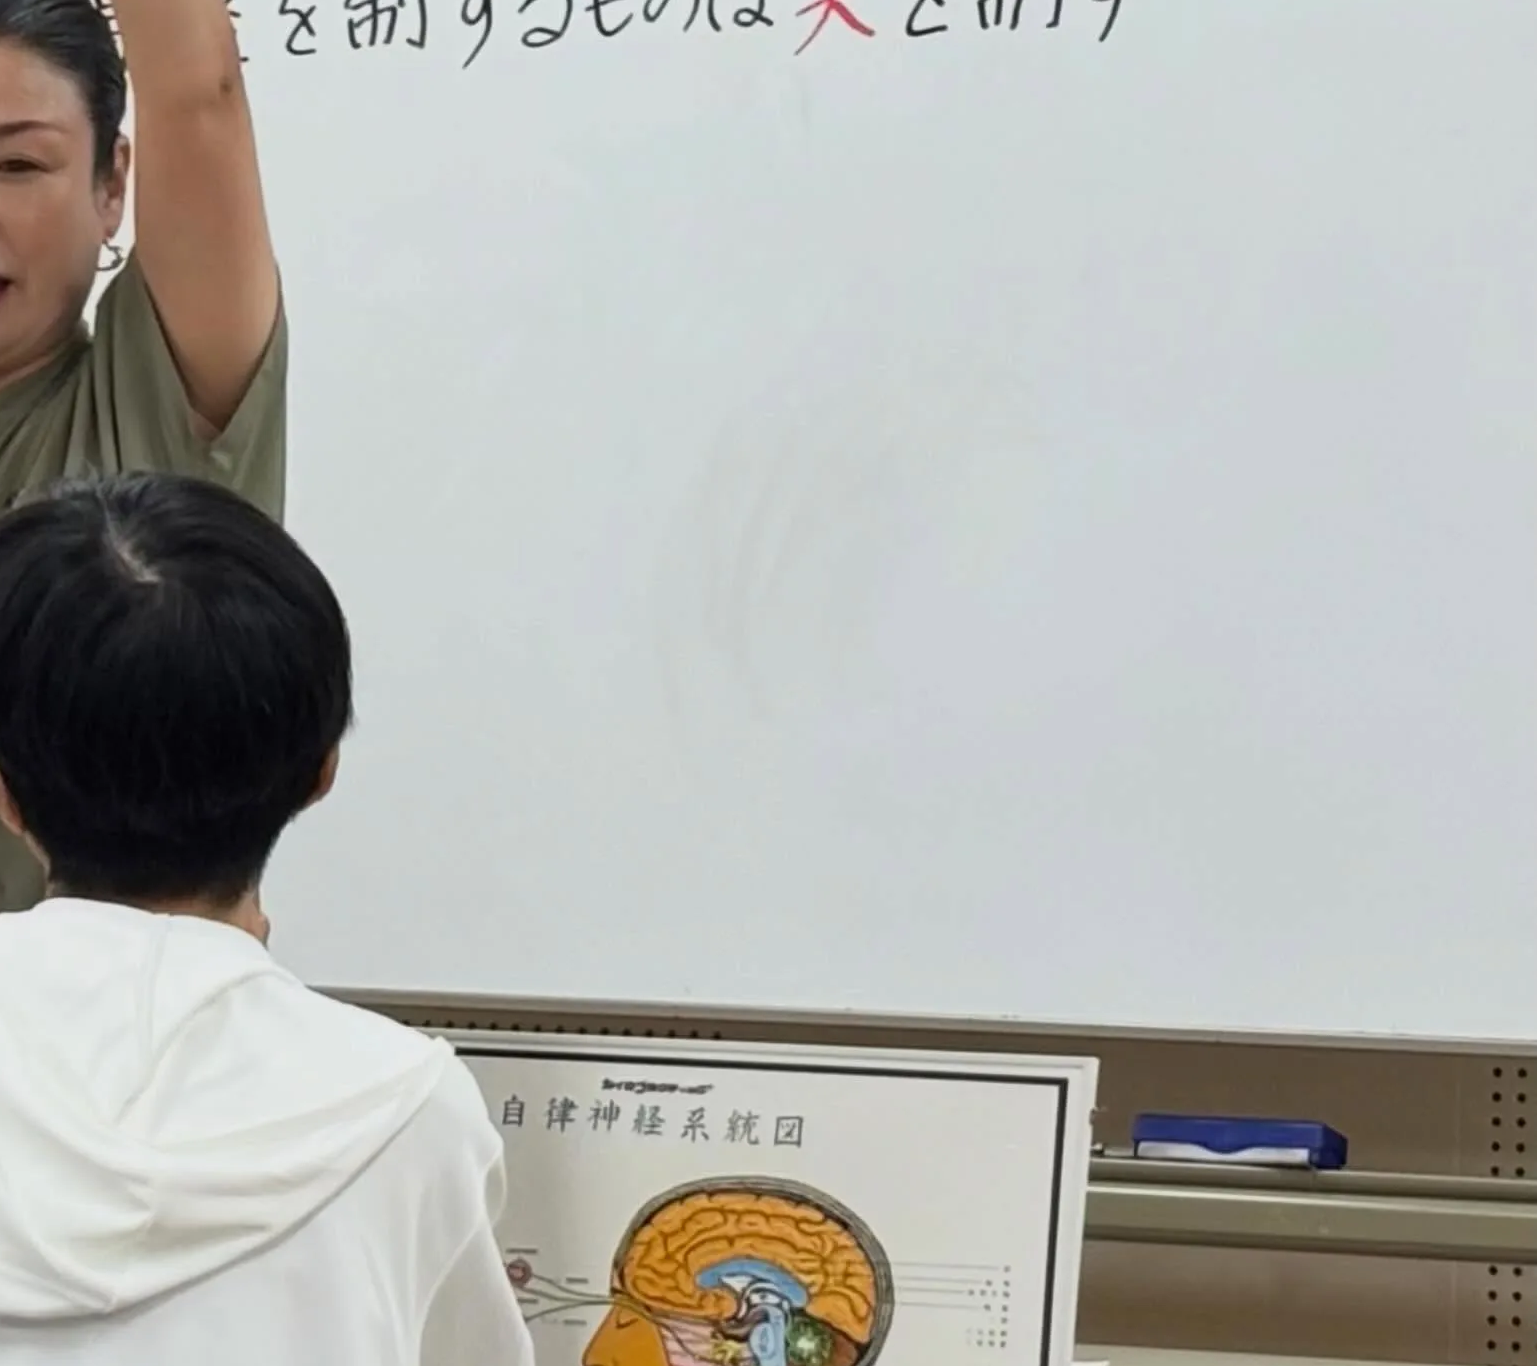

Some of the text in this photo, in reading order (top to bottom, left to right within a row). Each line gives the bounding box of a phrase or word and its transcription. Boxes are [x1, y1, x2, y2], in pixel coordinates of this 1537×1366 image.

[501, 1094, 805, 1149] 自律神経系統図
